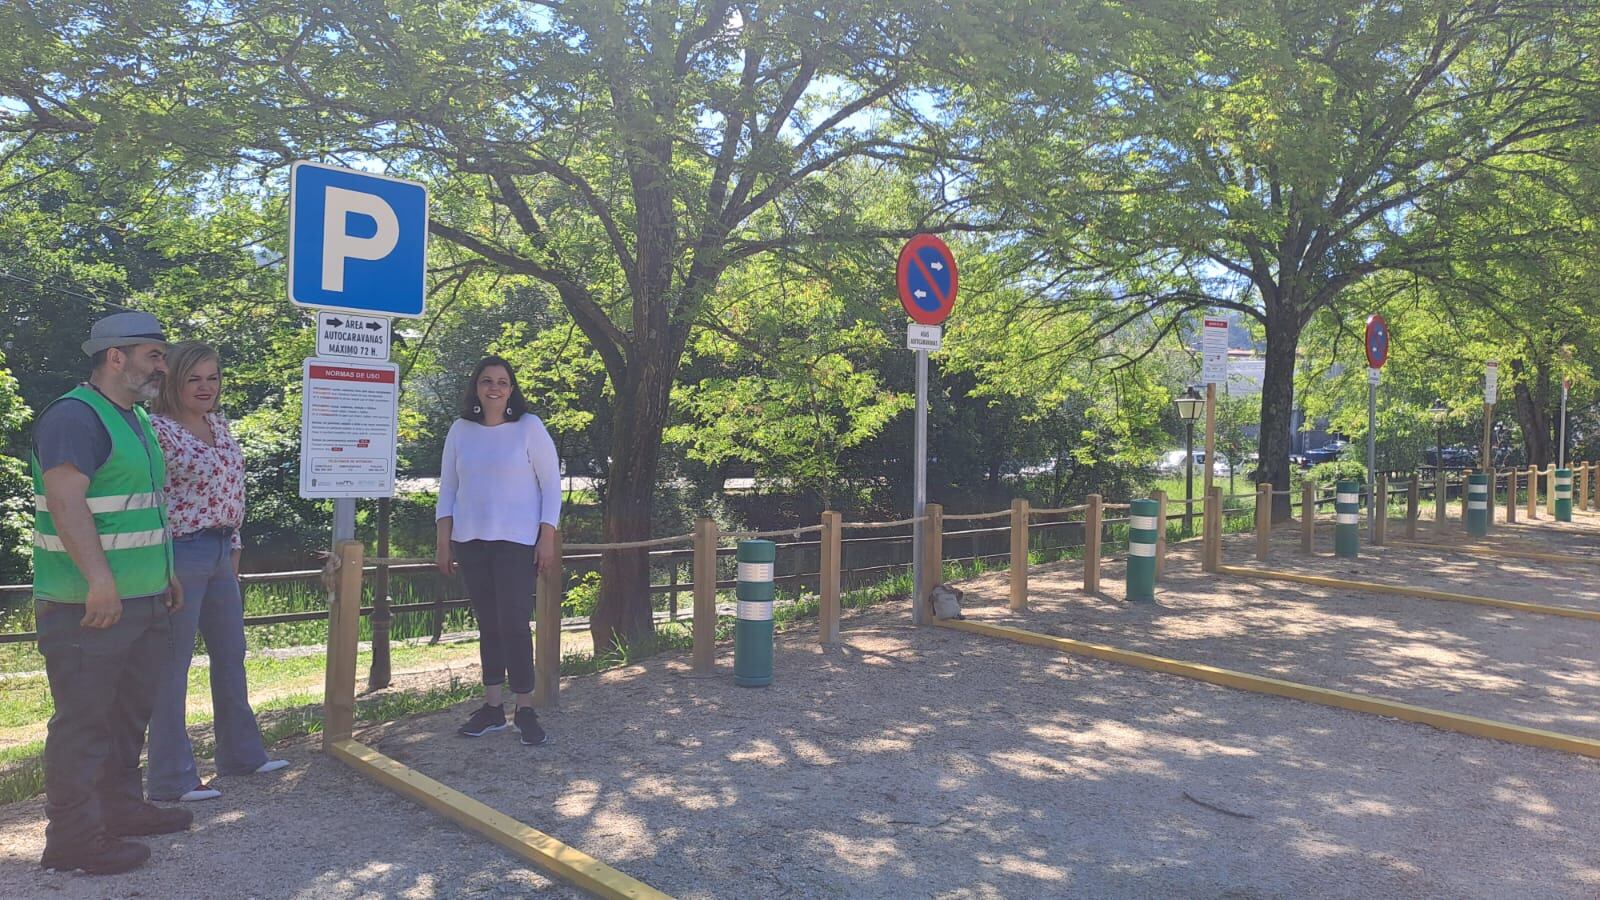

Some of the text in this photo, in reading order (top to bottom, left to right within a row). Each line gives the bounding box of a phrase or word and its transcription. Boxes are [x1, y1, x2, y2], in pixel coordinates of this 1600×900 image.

[321, 185, 399, 292] P
[324, 330, 383, 345] AUTOCARAVANAS
[328, 342, 358, 355] MÁXIMO
[360, 346, 369, 356] 72
[325, 370, 355, 378] NORMAS
